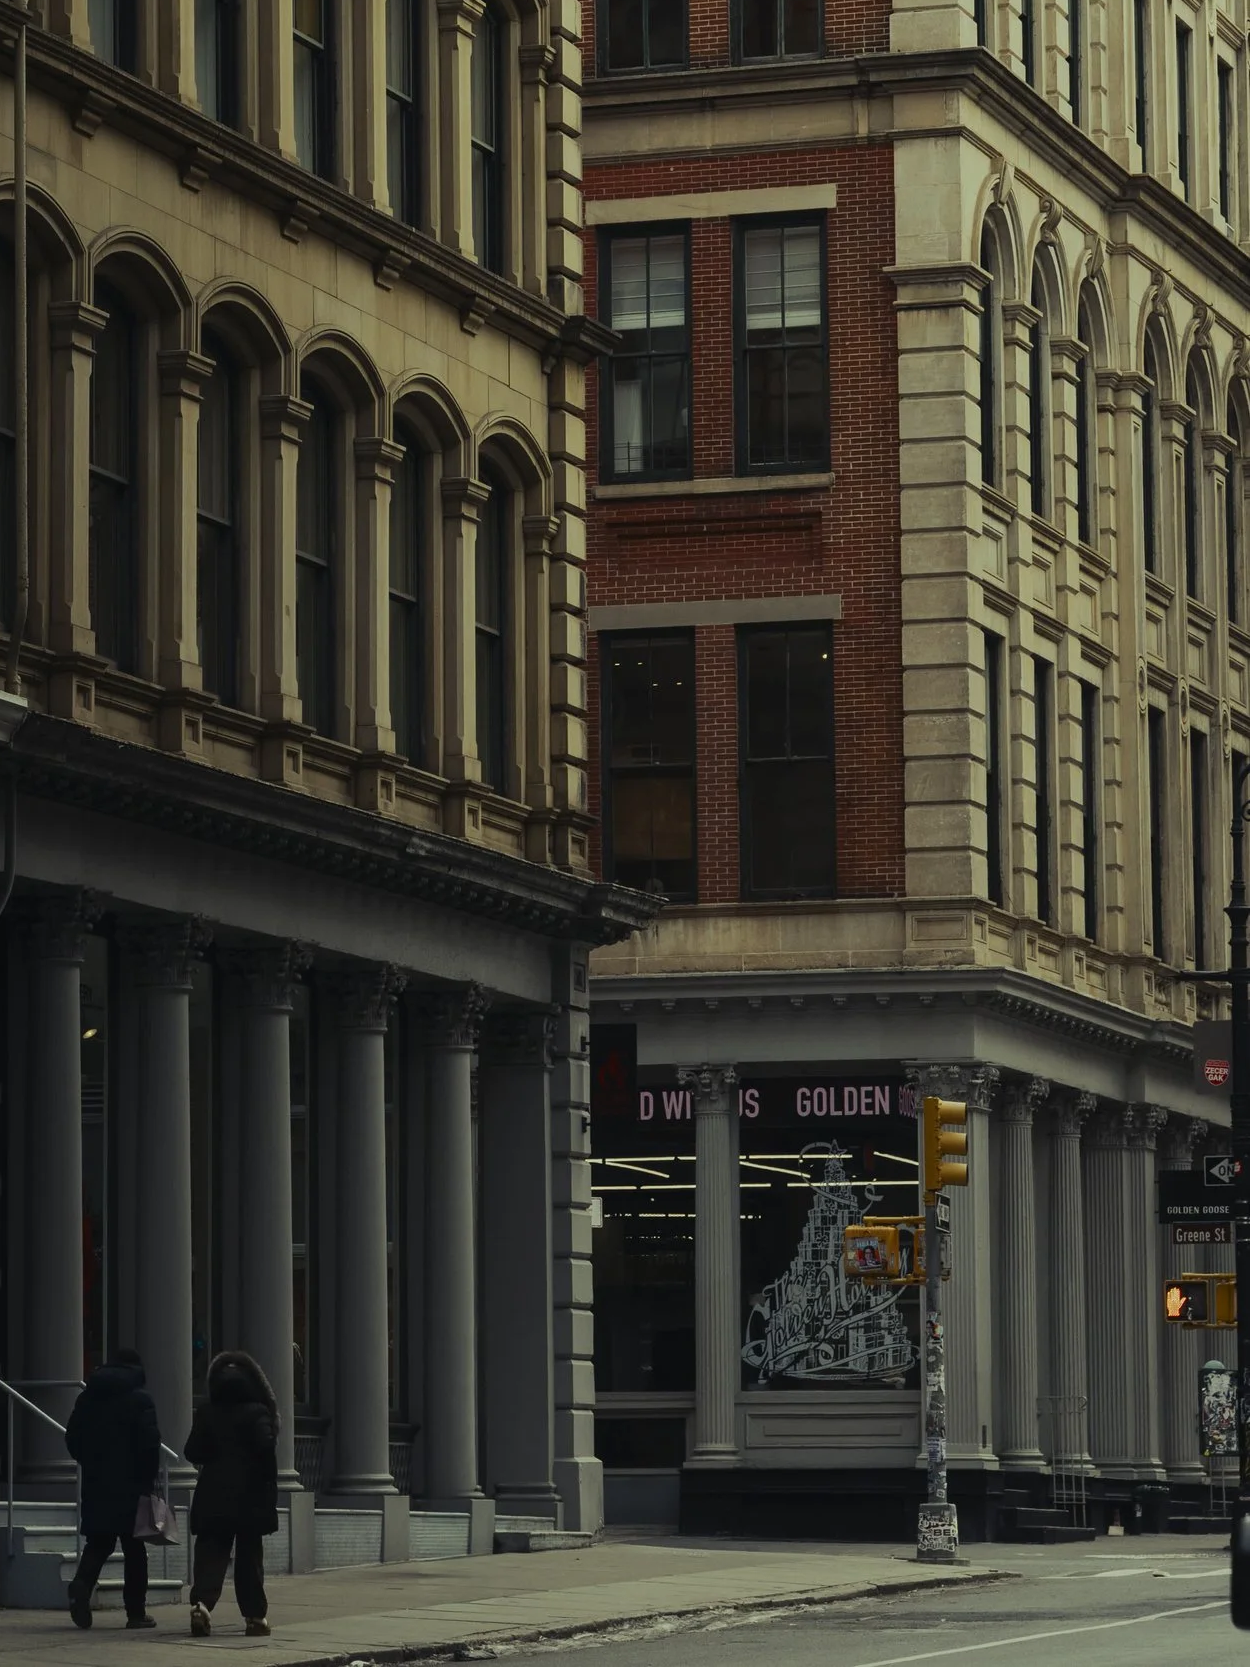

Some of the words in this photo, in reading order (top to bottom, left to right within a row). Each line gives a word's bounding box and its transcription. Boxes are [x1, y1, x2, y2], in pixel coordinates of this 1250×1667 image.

[1208, 1073, 1224, 1082] GAK
[662, 1090, 693, 1120] WI
[796, 1085, 890, 1117] GOLDEN
[1167, 1205, 1200, 1214] GOLDEN
[1202, 1205, 1230, 1214] GOOSE
[1176, 1228, 1211, 1242] Greene
[1214, 1227, 1226, 1241] St
